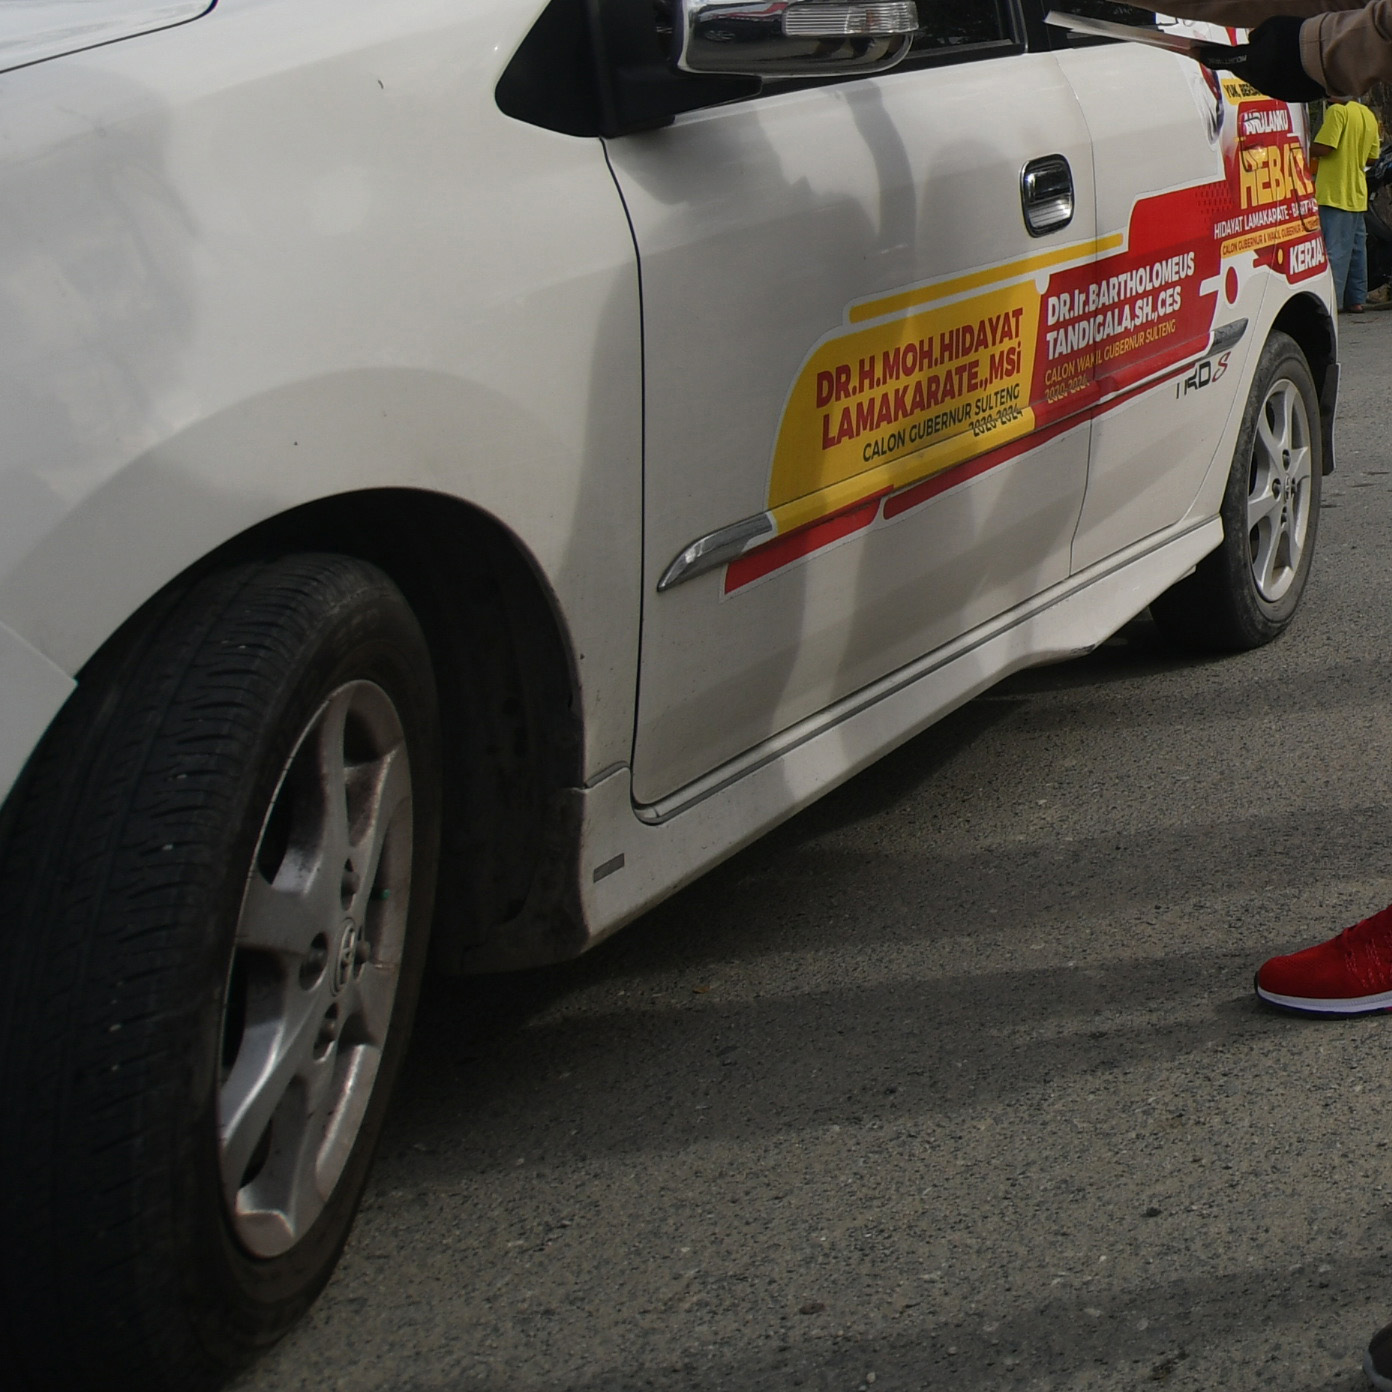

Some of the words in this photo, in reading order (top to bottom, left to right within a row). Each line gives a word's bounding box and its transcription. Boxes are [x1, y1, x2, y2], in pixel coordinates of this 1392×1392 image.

[1214, 216, 1243, 240] HIDAYAT
[1047, 251, 1195, 326] DR.Ir.BARTHOLOMEUS
[816, 306, 1023, 409] DR.H.MOH.HIDAYAT
[1044, 360, 1075, 386] CALON
[1077, 347, 1101, 374] WAKIL
[1104, 333, 1145, 360] GUBERNUR
[1146, 319, 1176, 343] SULTENG
[862, 431, 905, 463] CALON
[908, 402, 972, 444] GUBERNUR
[974, 383, 1020, 415] SULTENG
